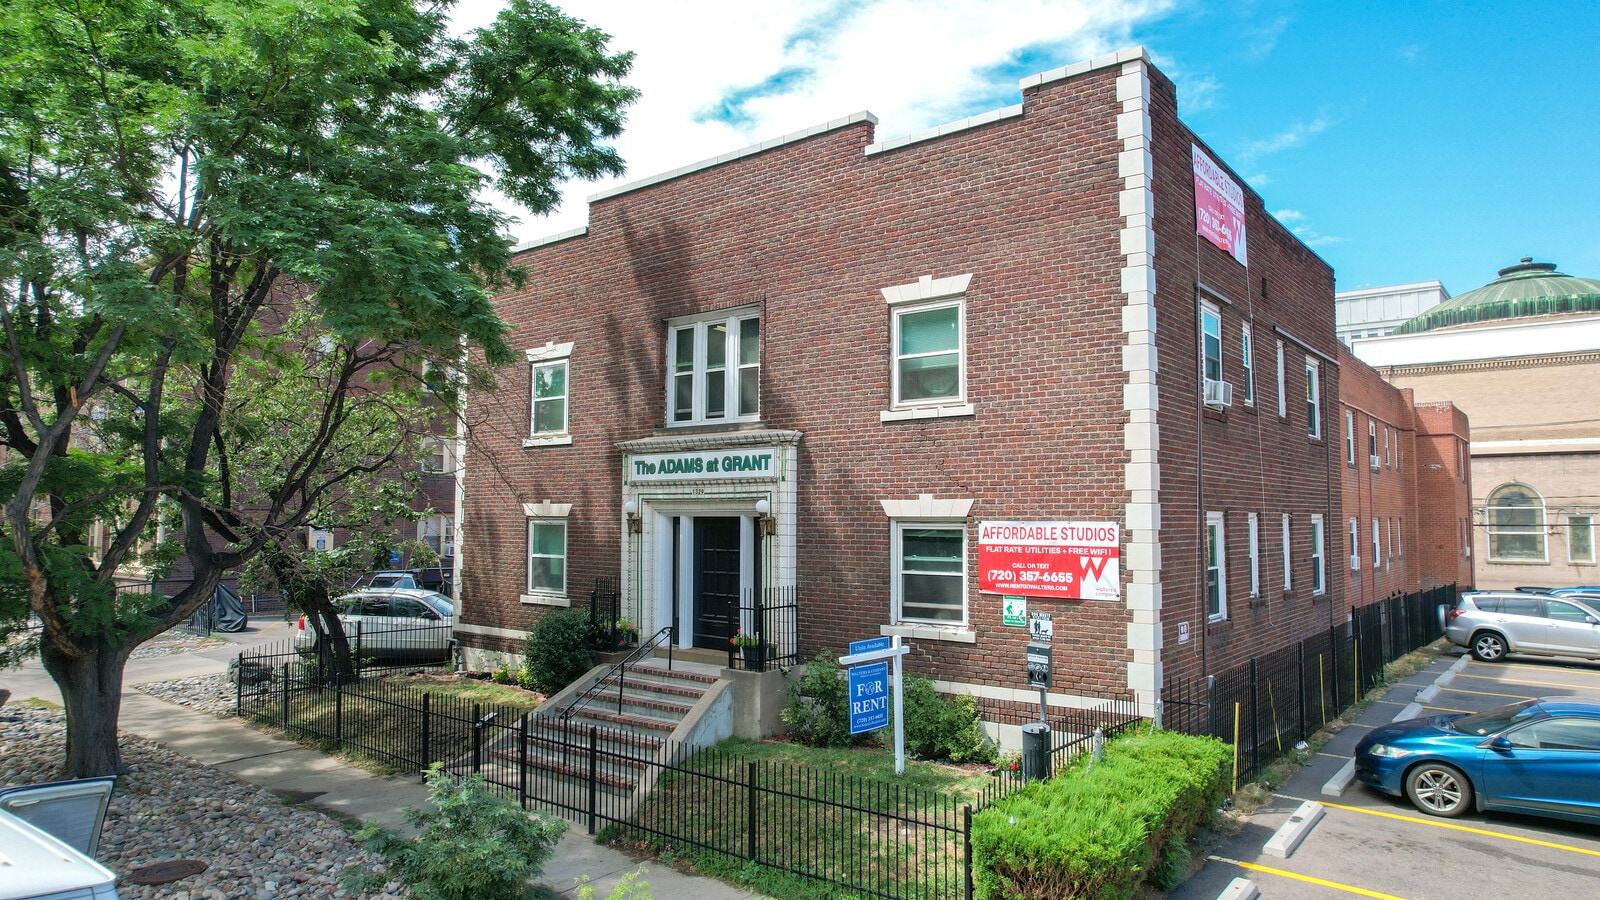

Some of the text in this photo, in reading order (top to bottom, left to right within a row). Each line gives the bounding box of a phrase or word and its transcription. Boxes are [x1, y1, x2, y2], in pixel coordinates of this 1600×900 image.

[1193, 151, 1224, 191] AFFORDABLE
[634, 454, 772, 475] The ADAMS at GRANT
[982, 526, 1115, 542] AFFORDABLE STUDIOS
[985, 545, 1003, 553] FLAT
[1025, 547, 1061, 555] UTILITIES
[1068, 547, 1089, 555] FREE
[987, 570, 1074, 584] (720) 357-6655
[856, 680, 883, 697] FOR
[852, 696, 887, 715] RENT
